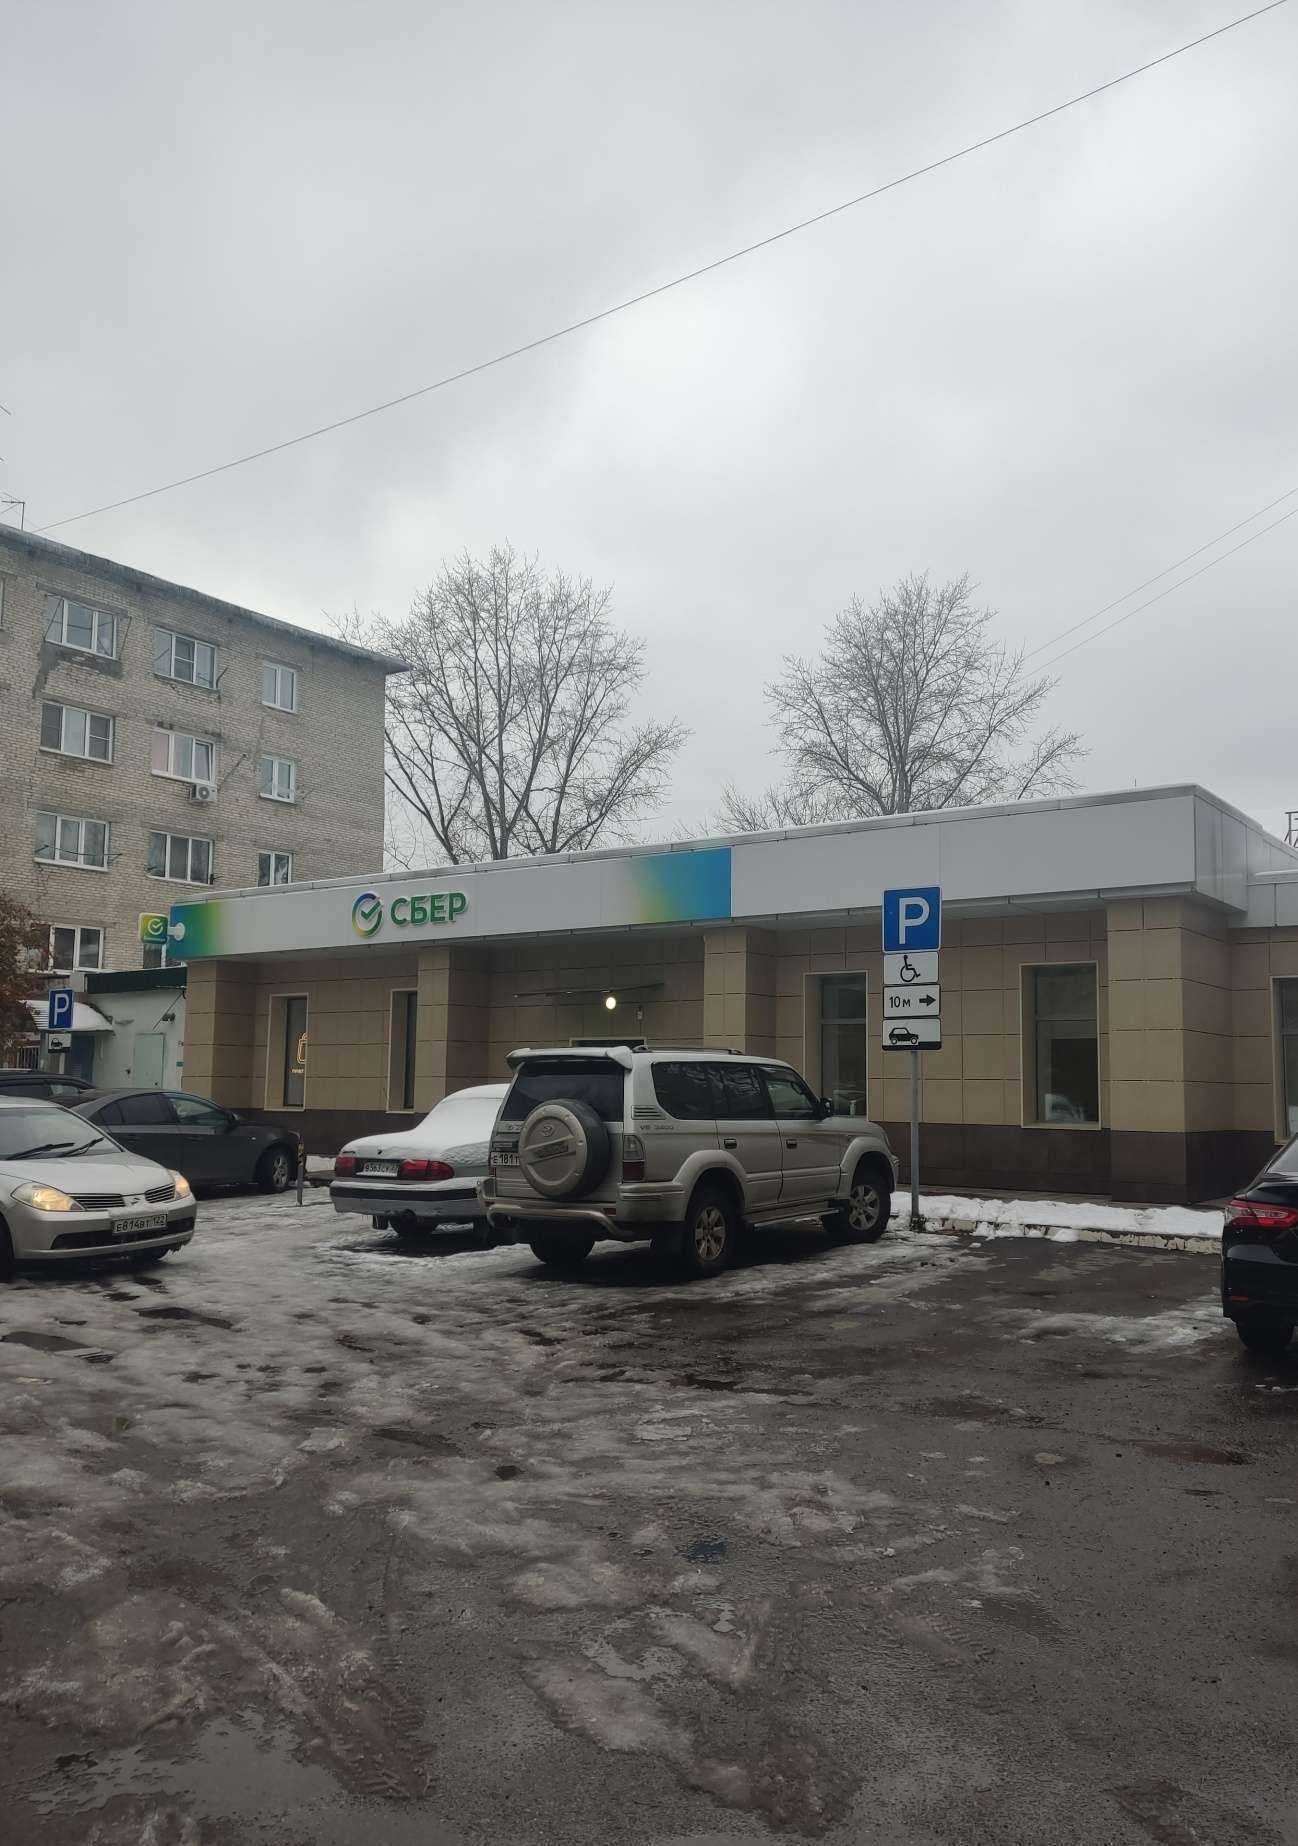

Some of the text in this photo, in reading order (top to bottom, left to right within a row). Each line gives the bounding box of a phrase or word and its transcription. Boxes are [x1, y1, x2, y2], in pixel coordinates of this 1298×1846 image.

[391, 892, 467, 926] СБЕР
[899, 896, 930, 945] P
[54, 993, 70, 1026] P
